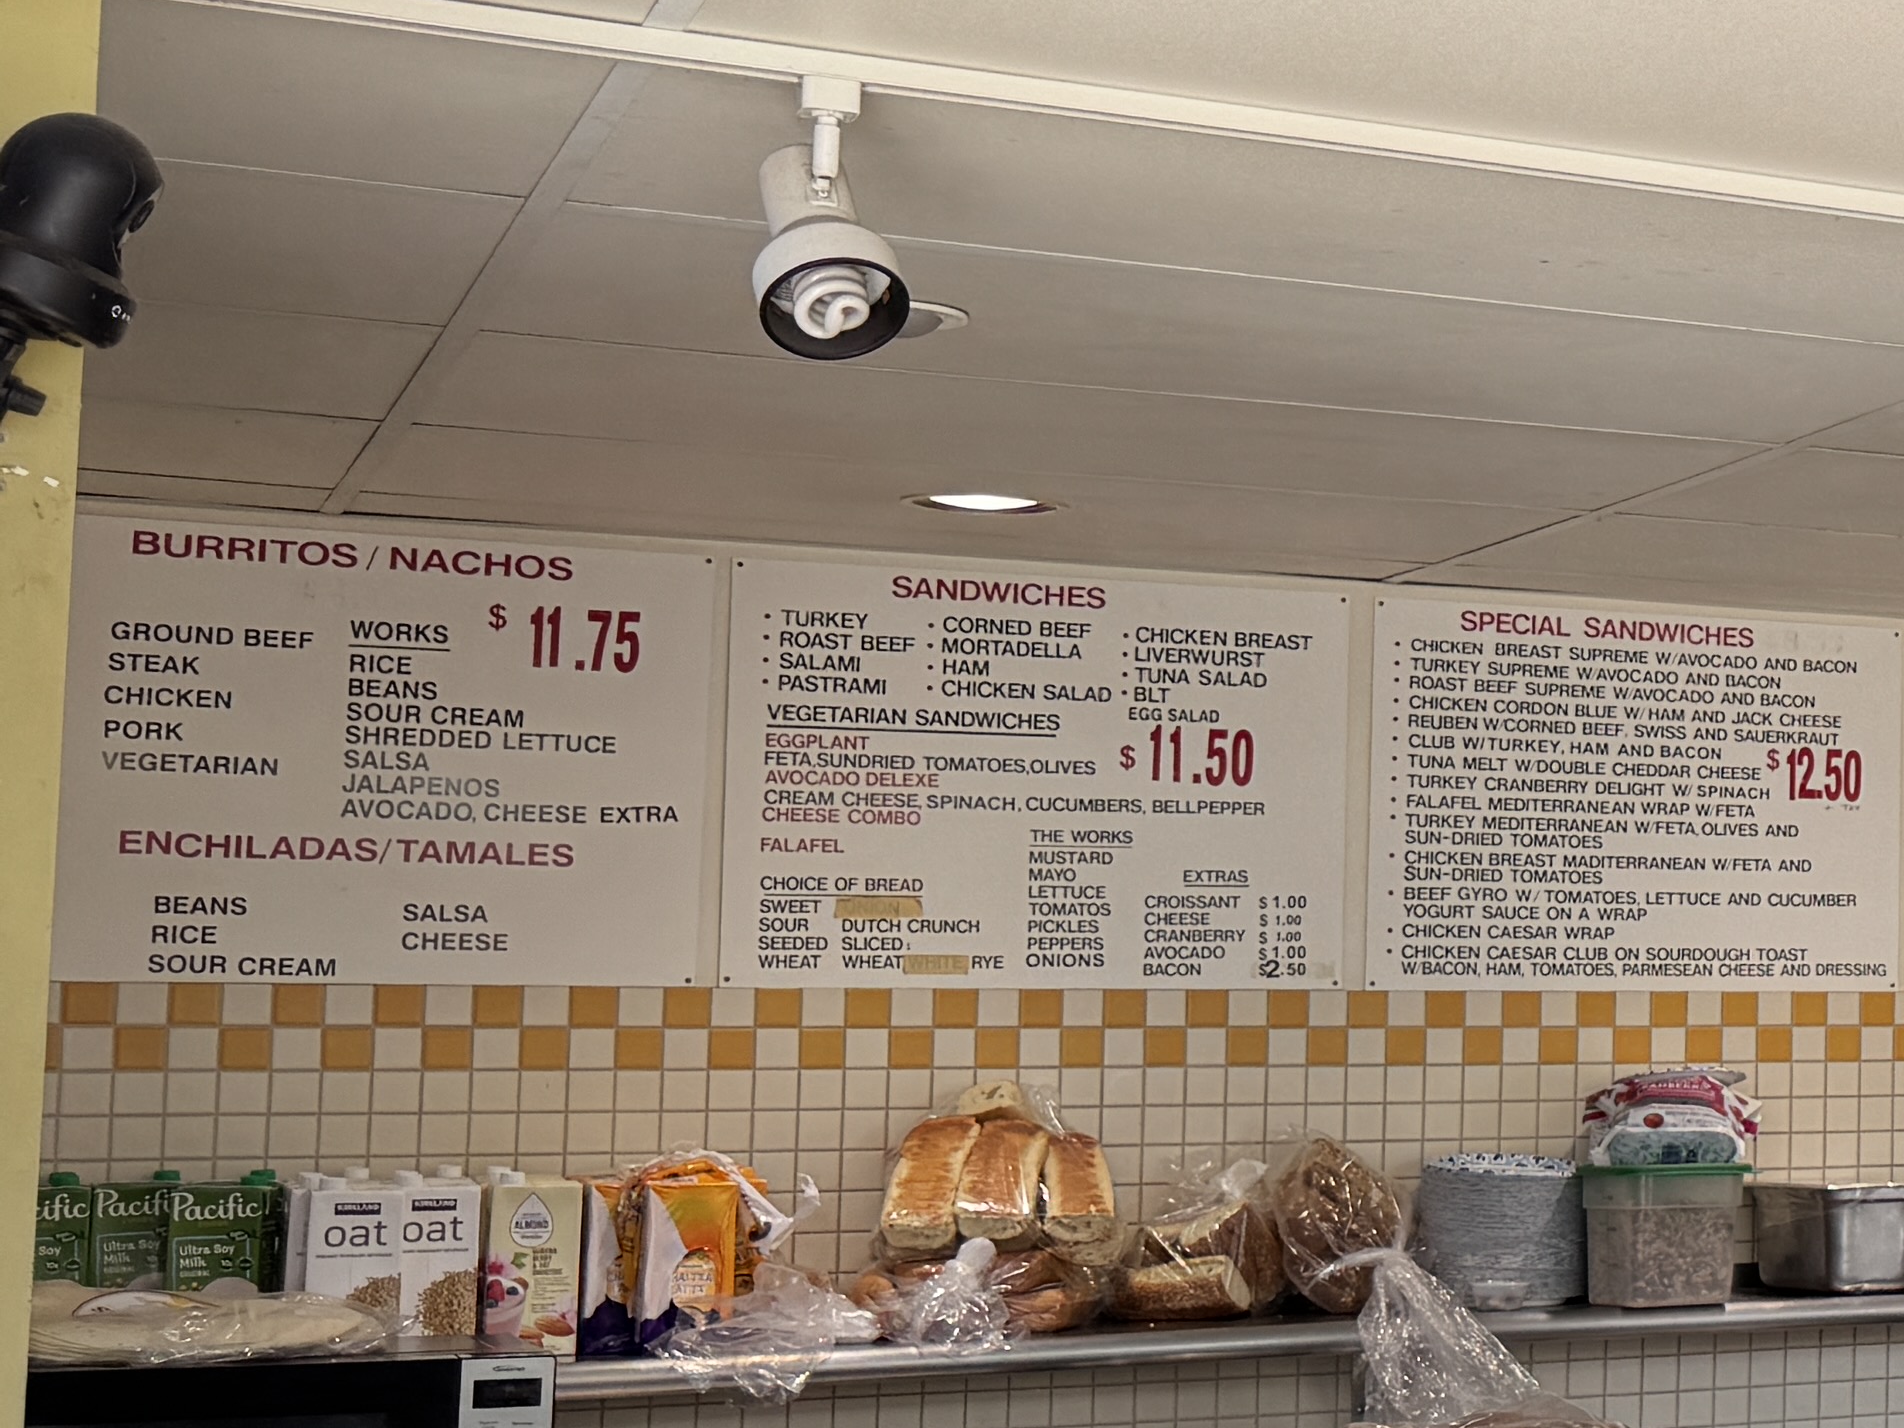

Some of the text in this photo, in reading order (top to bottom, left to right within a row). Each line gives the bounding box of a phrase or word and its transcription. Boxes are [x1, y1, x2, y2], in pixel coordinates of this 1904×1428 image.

[131, 529, 358, 570] BURRITOS
[389, 547, 573, 581] NACHOS
[892, 576, 1106, 609] SANDWICHES
[781, 610, 868, 629] TURKEY
[1461, 610, 1755, 648] SPECIAL SANDWICHES
[110, 621, 314, 650] GROUND BEEF
[350, 621, 449, 644] WORKS
[488, 604, 642, 673] $ 11.75
[780, 631, 916, 653] ROAST BEEF
[942, 639, 1082, 660] MORTADELLA
[1134, 647, 1266, 668] LIVERWURST
[1411, 639, 1857, 673] CHICKEN BREAST SUPREME W/AVOCADO AND BACON
[107, 653, 199, 675] STEAK
[349, 655, 412, 675] RICE
[779, 653, 861, 672] SALAMI
[104, 686, 232, 709] CHICKEN
[348, 679, 437, 699] BEANS
[346, 703, 523, 728] SOUR CREAM
[767, 705, 1060, 731] VEGETARIAN SANDWICHES
[345, 726, 616, 754] SHREDDED LETTUCE
[765, 734, 870, 751] EGGPLANT
[1409, 735, 1455, 750] CLUB
[1570, 741, 1609, 756] HAM
[1617, 743, 1654, 757] AND
[1660, 744, 1722, 760] BACON
[102, 752, 278, 775] VEGETARIAN
[344, 750, 429, 770] SALSA
[1119, 725, 1255, 787] $ 11.50
[341, 774, 499, 798] JALAPENOS
[1766, 748, 1861, 802] $ 12.50
[484, 803, 587, 824] CHEESE
[599, 805, 678, 825] EXTRA
[760, 837, 845, 855] FALAFEL
[1030, 829, 1134, 846] THE WORKS
[1183, 869, 1249, 885] EXTRAS
[1402, 925, 1615, 940] CHICKEN CAESAR WRAP
[170, 1192, 262, 1221] Pacific
[324, 1221, 388, 1247] oat
[403, 1215, 464, 1243] oat
